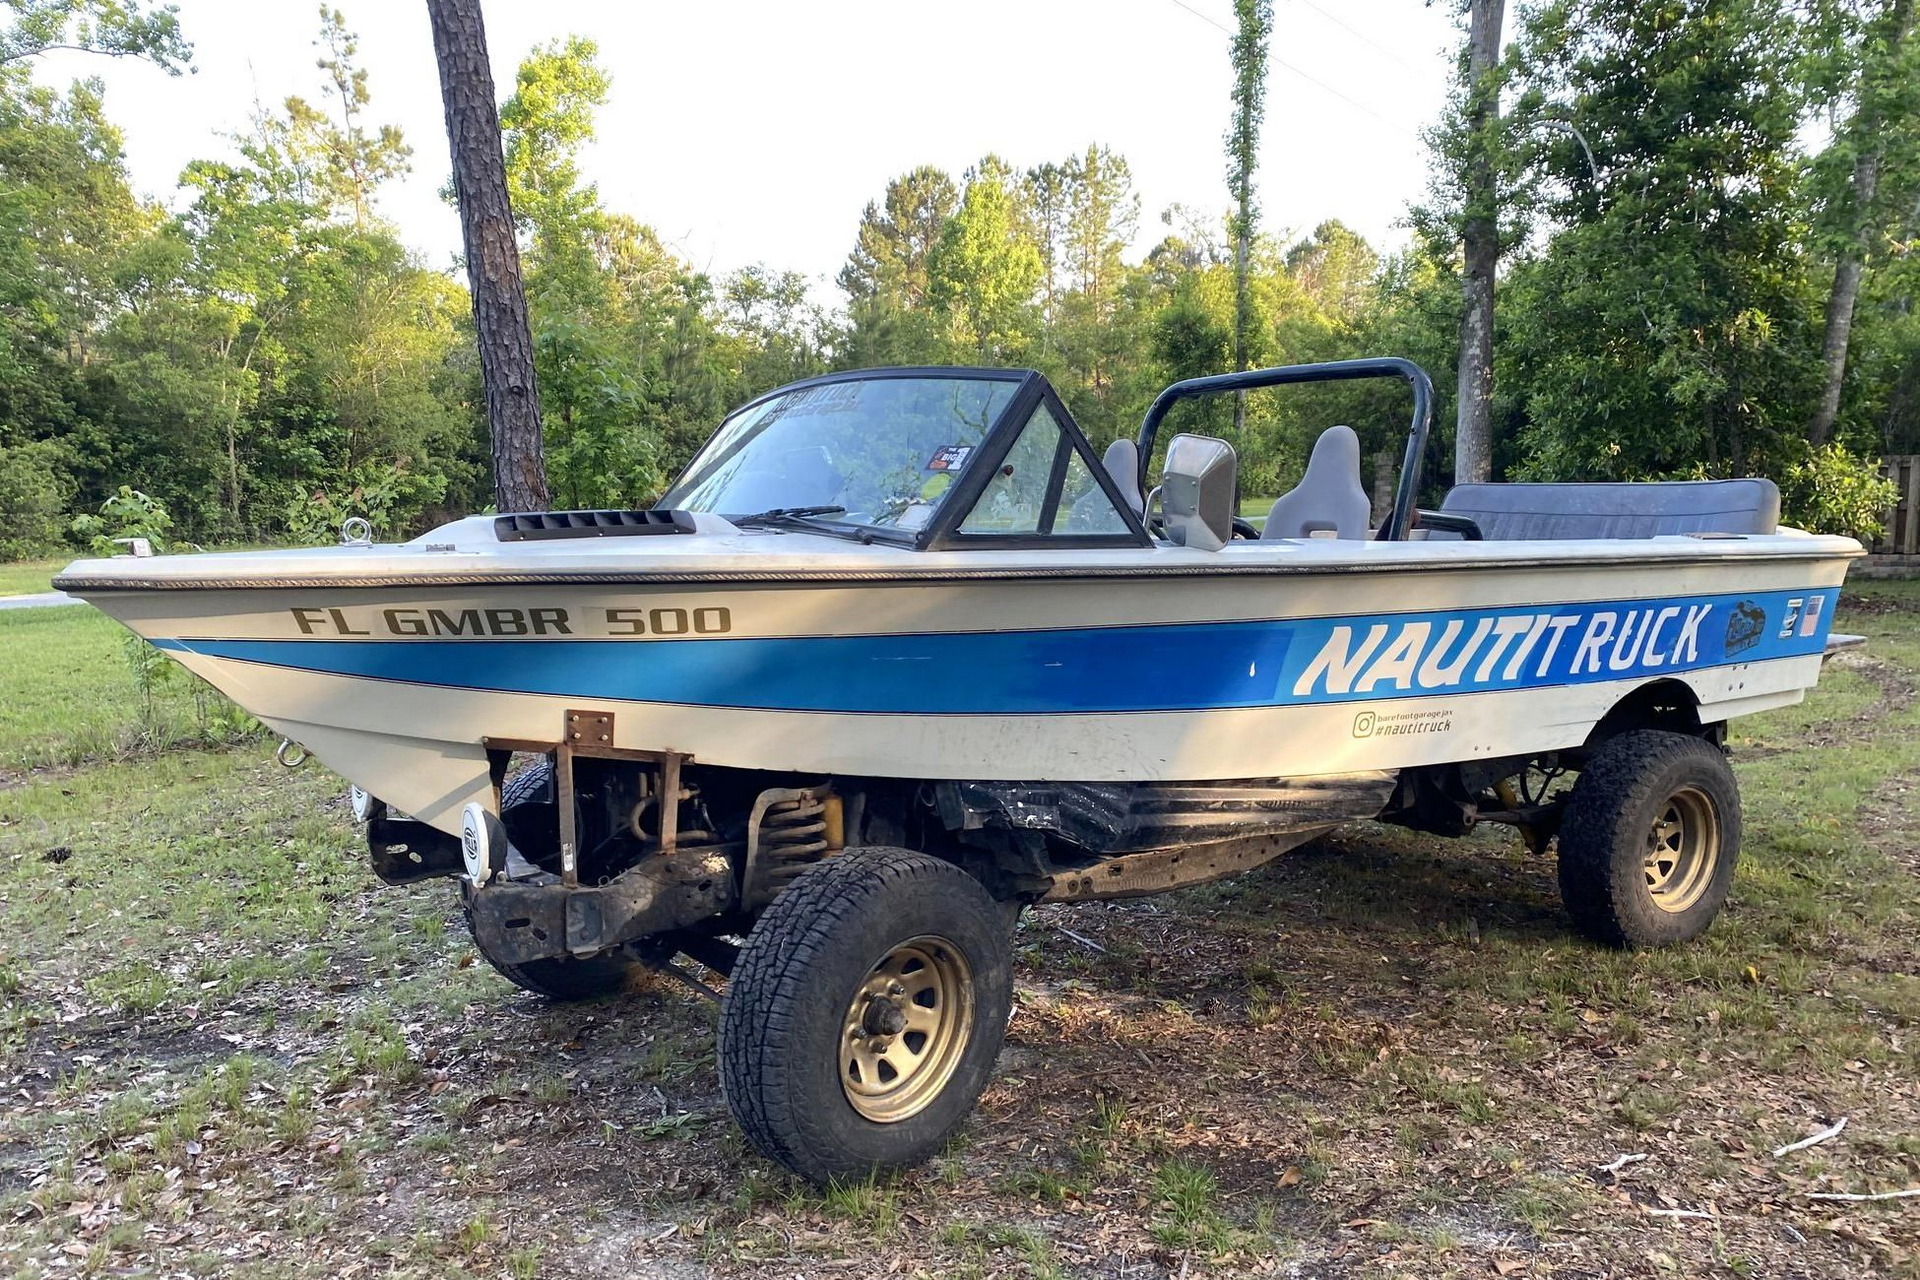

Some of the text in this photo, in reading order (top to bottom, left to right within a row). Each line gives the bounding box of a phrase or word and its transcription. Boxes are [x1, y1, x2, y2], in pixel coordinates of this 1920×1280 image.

[941, 453, 958, 461] BIG
[290, 606, 732, 636] FL GMBR 500
[1292, 603, 1713, 696] NAUTITRUCK
[1375, 719, 1452, 736] #nautitruck
